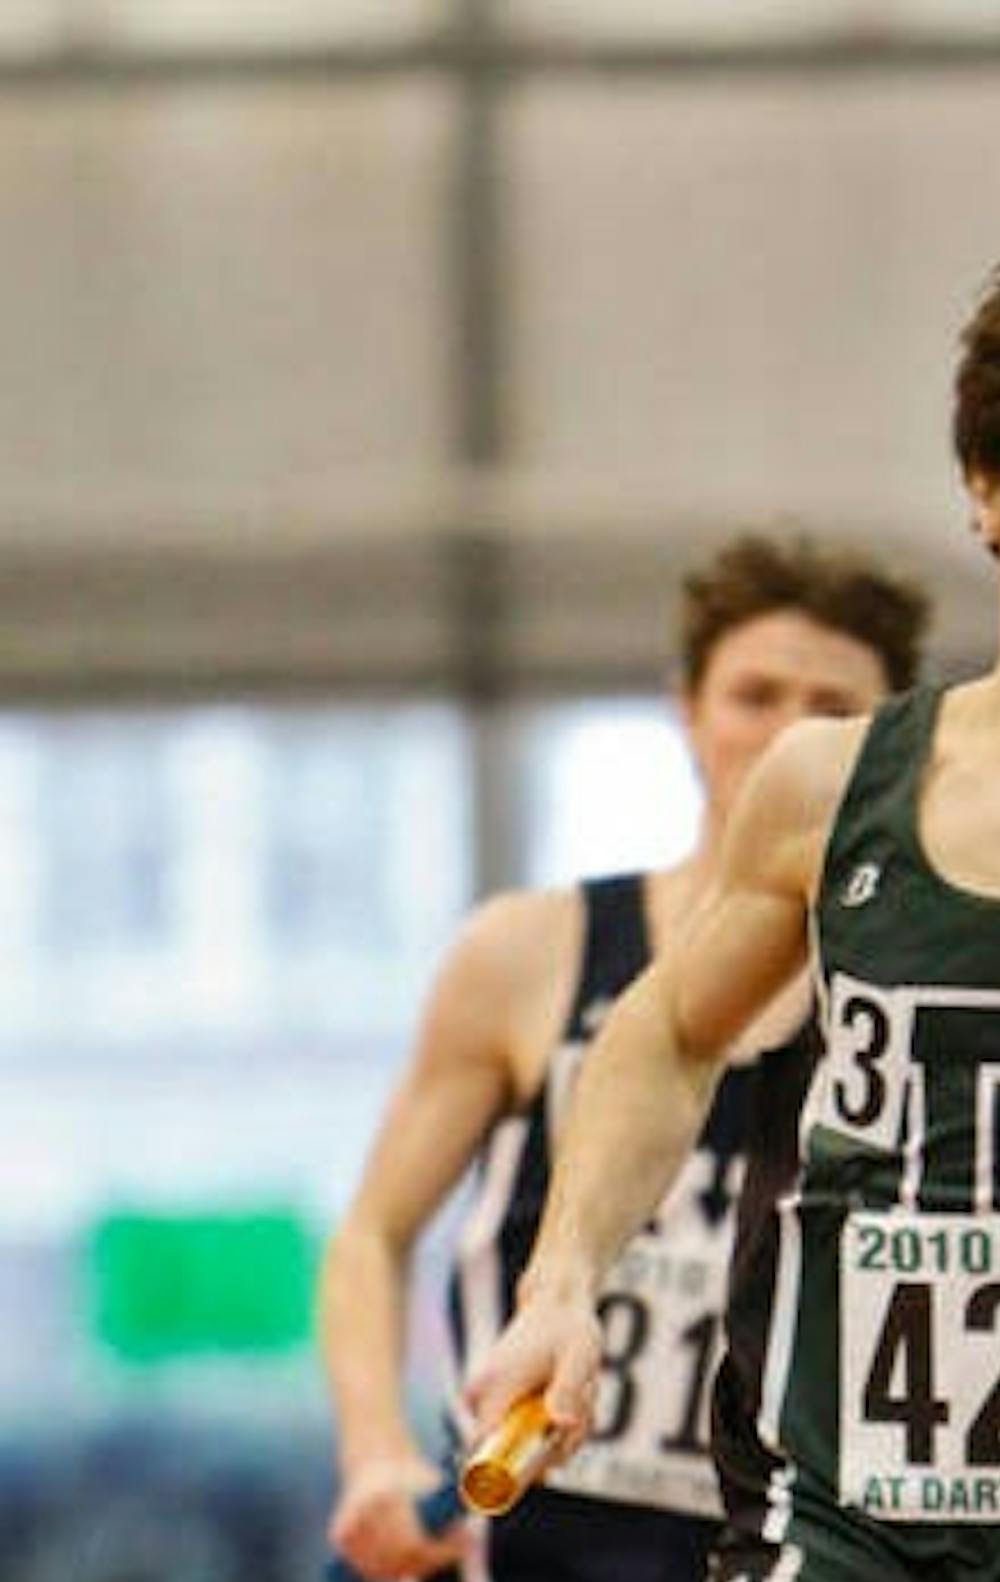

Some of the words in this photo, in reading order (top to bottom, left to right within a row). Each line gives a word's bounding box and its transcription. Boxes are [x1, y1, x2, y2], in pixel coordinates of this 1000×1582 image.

[833, 996, 890, 1127] 3
[856, 1227, 991, 1273] 2010
[864, 1474, 906, 1511] AT
